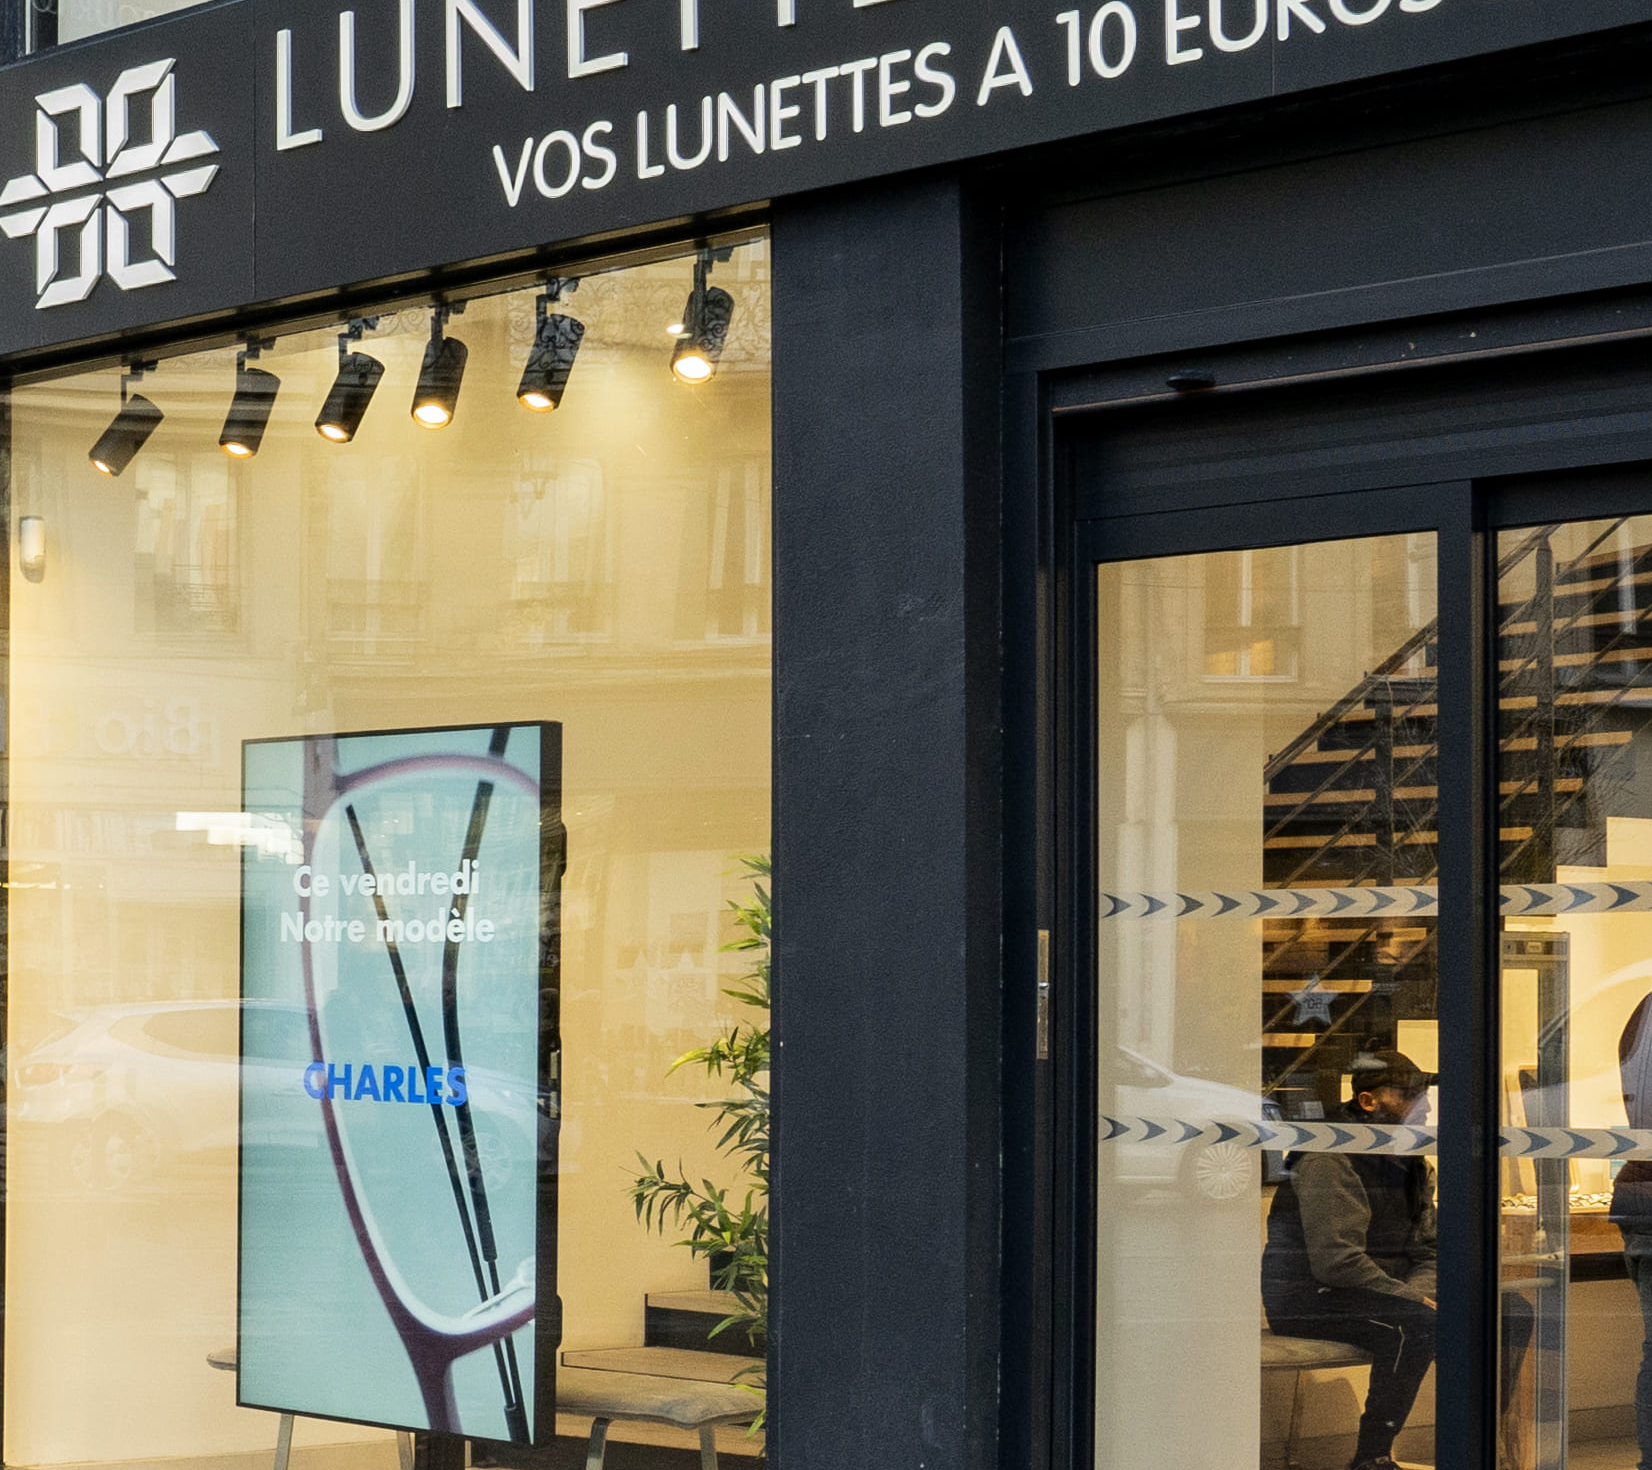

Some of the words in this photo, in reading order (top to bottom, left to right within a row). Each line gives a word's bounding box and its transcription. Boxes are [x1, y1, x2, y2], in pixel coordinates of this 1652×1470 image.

[492, 120, 617, 208] VOS
[636, 41, 956, 180] LUNETTES
[976, 25, 1033, 107] A
[1055, 0, 1137, 87] 10
[293, 865, 330, 898] Ce
[339, 859, 481, 896] vendredi
[280, 911, 366, 943] Notre
[376, 907, 496, 943] modèle
[303, 1061, 468, 1107] CHARLES
